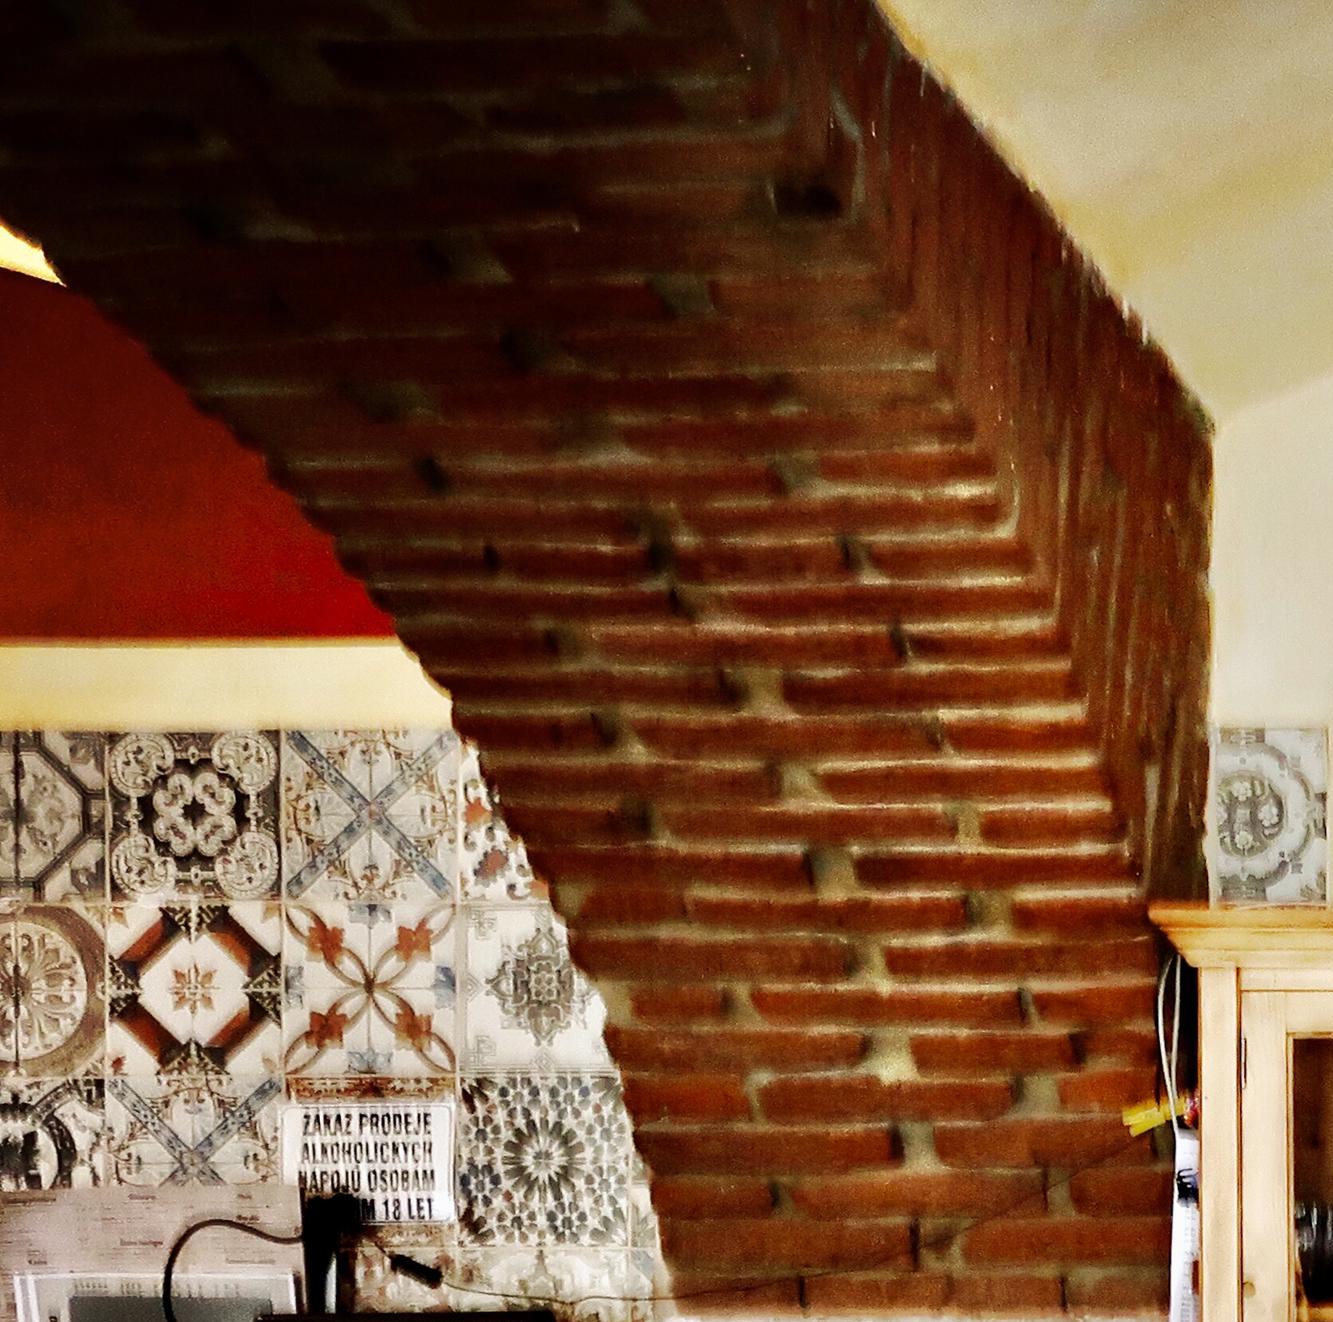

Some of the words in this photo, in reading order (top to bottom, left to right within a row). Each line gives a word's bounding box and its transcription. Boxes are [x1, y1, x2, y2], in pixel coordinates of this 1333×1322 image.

[359, 1111, 433, 1136] PRODEJE
[383, 1197, 401, 1221] 18
[407, 1197, 434, 1221] LET
